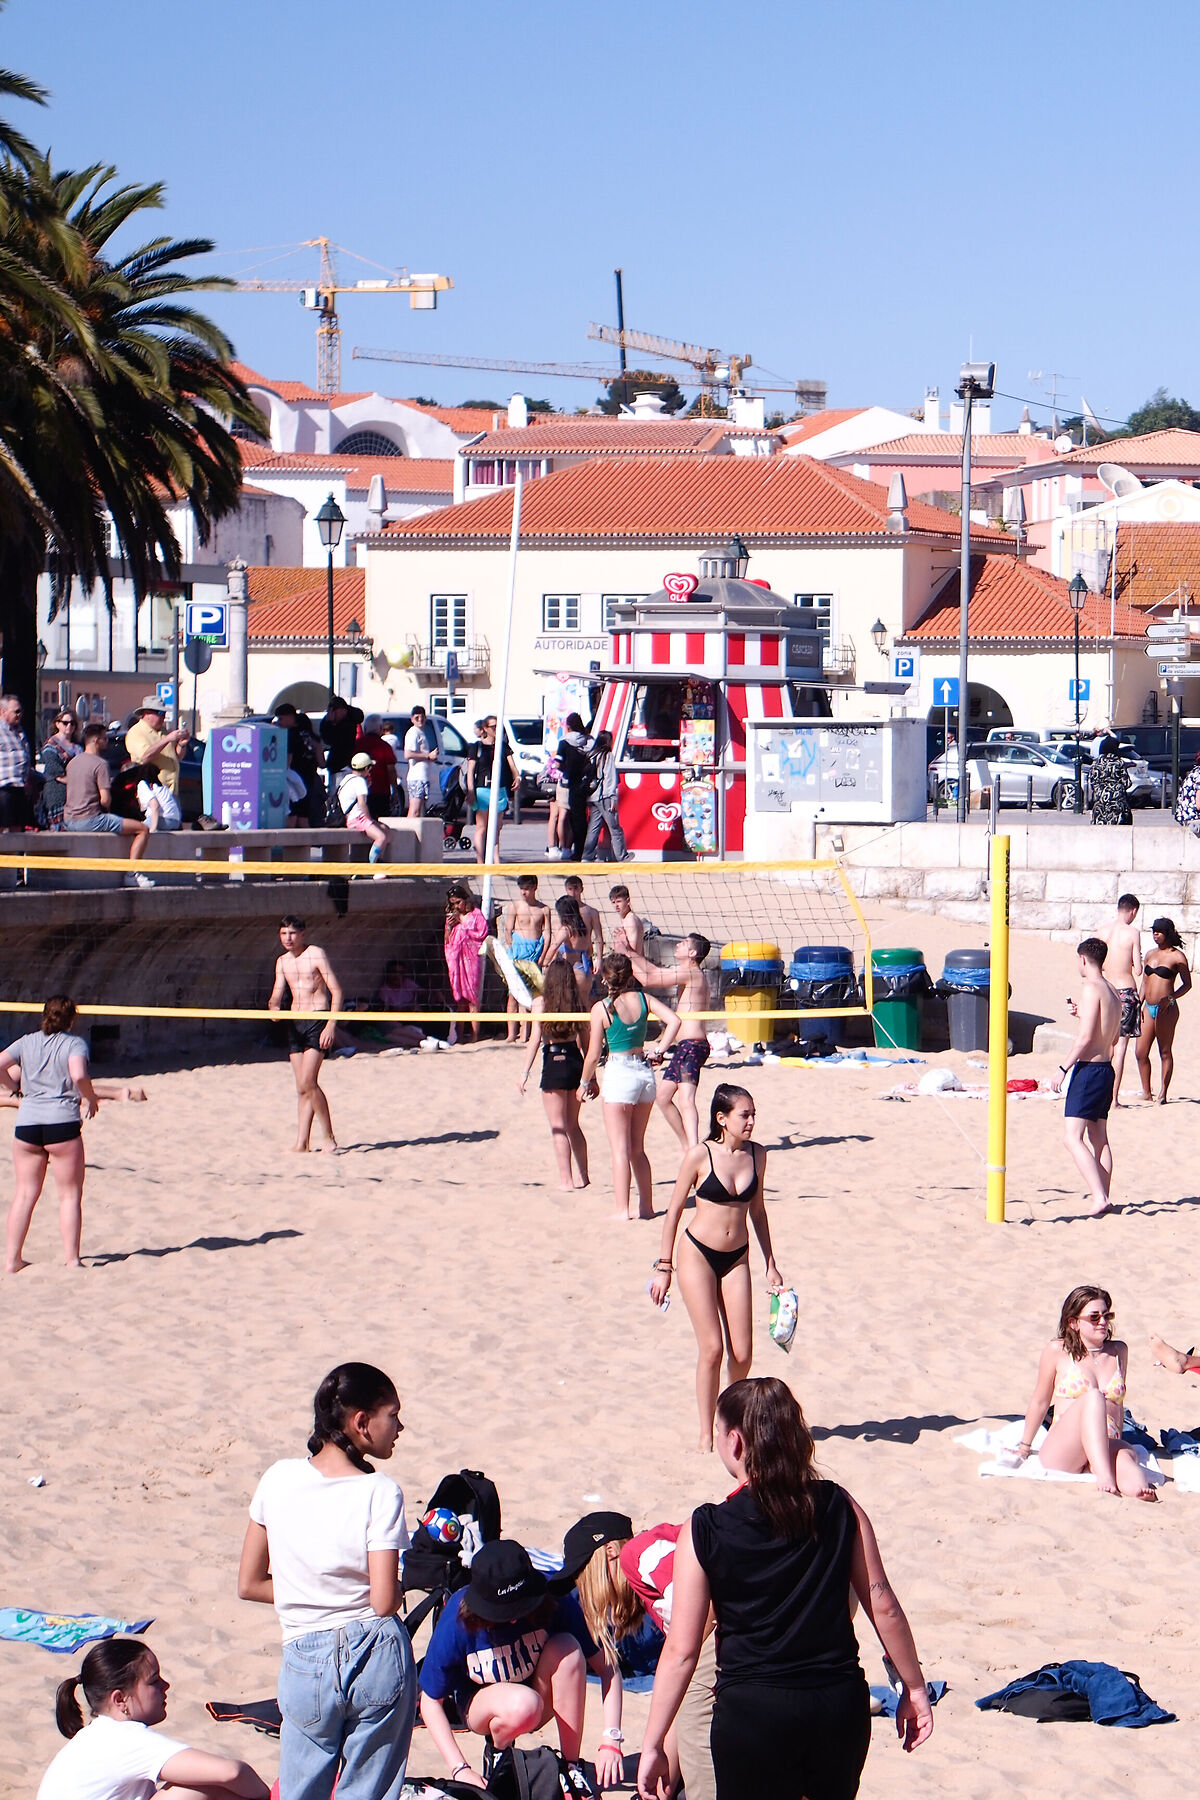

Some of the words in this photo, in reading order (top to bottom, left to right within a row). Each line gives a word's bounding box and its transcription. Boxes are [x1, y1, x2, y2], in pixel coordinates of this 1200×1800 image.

[191, 606, 222, 633] P
[534, 640, 609, 650] AUTORIDADE
[449, 655, 456, 676] P
[898, 658, 911, 676] P
[160, 686, 173, 701] P
[1073, 680, 1086, 699] P
